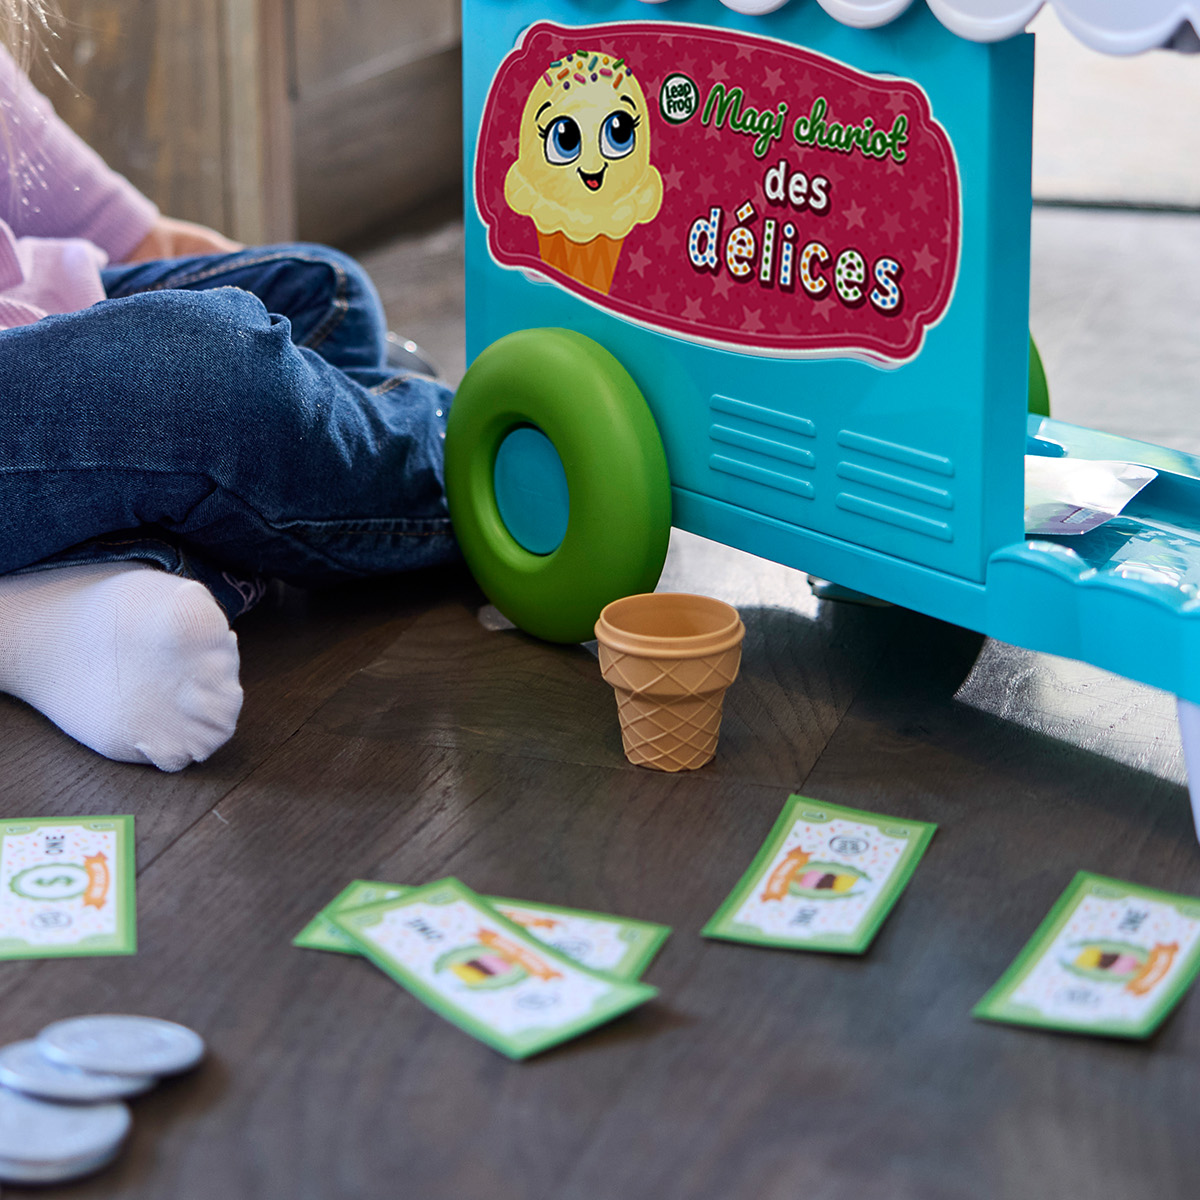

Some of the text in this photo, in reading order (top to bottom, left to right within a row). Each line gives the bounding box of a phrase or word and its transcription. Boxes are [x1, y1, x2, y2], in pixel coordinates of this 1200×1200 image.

[665, 83, 692, 99] Leap
[666, 97, 693, 115] Frog
[701, 82, 908, 162] Magi chariot
[764, 161, 828, 210] des
[688, 201, 900, 310] délices
